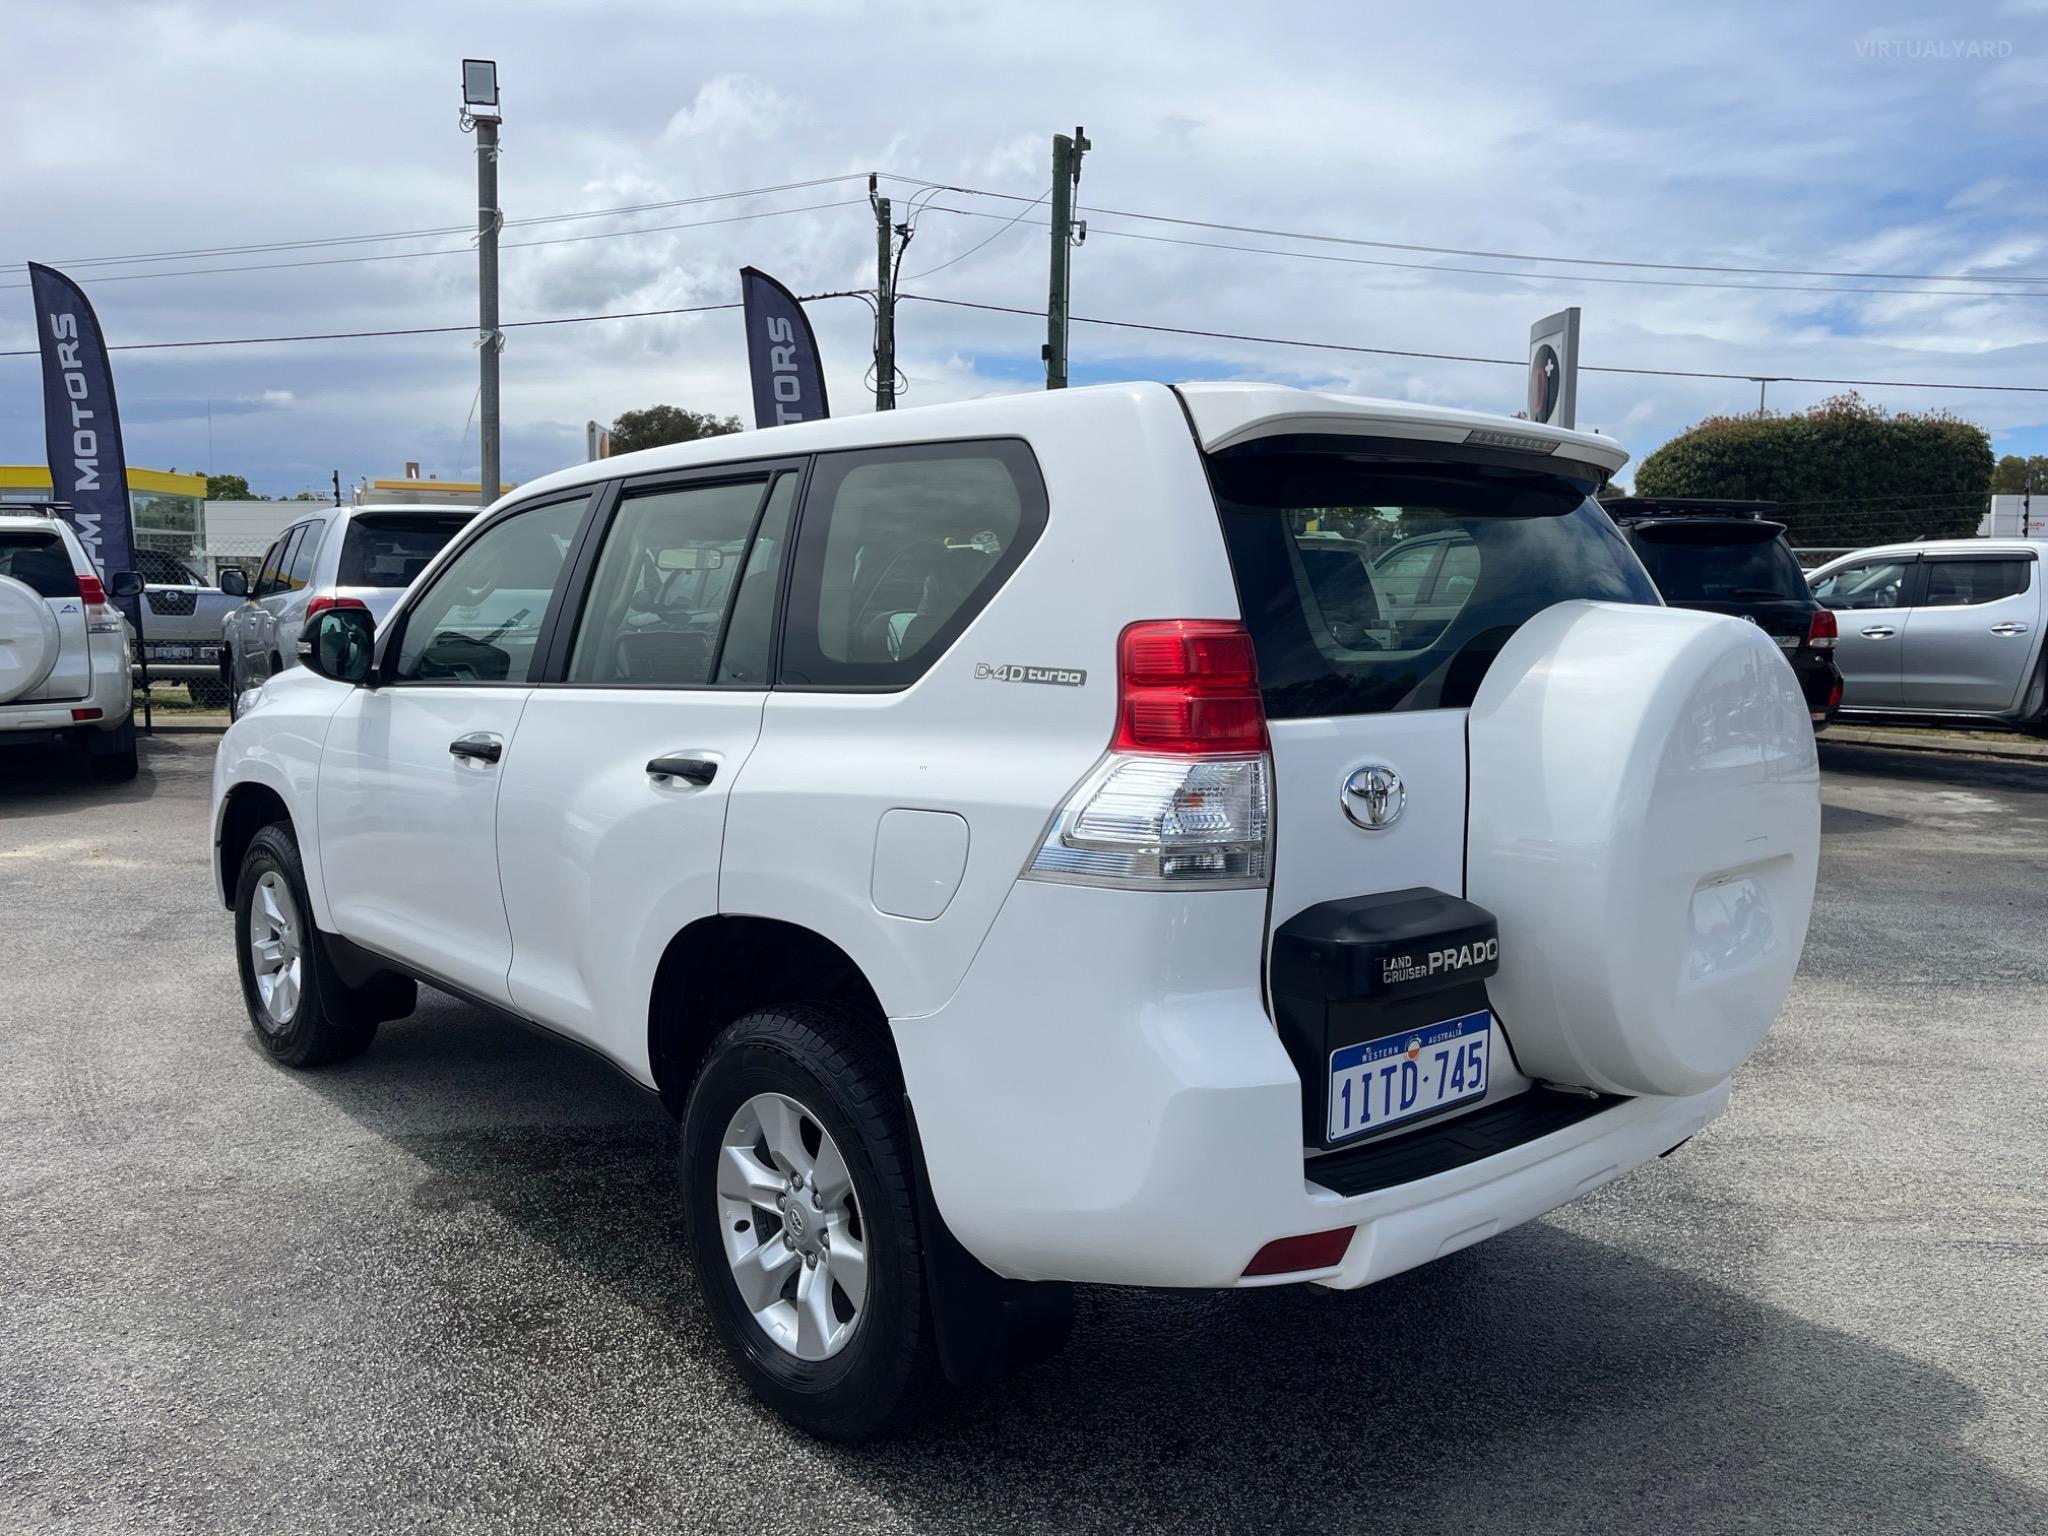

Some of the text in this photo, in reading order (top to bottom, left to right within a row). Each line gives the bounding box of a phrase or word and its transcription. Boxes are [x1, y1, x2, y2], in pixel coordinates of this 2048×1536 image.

[50, 313, 100, 492] MOTORS
[1028, 668, 1082, 684] turbo
[1383, 955, 1413, 971] LAND
[1428, 938, 1498, 975] PRADO
[1383, 965, 1427, 984] CRUISER
[1362, 1028, 1463, 1062] WESTERN AUSTRALIA
